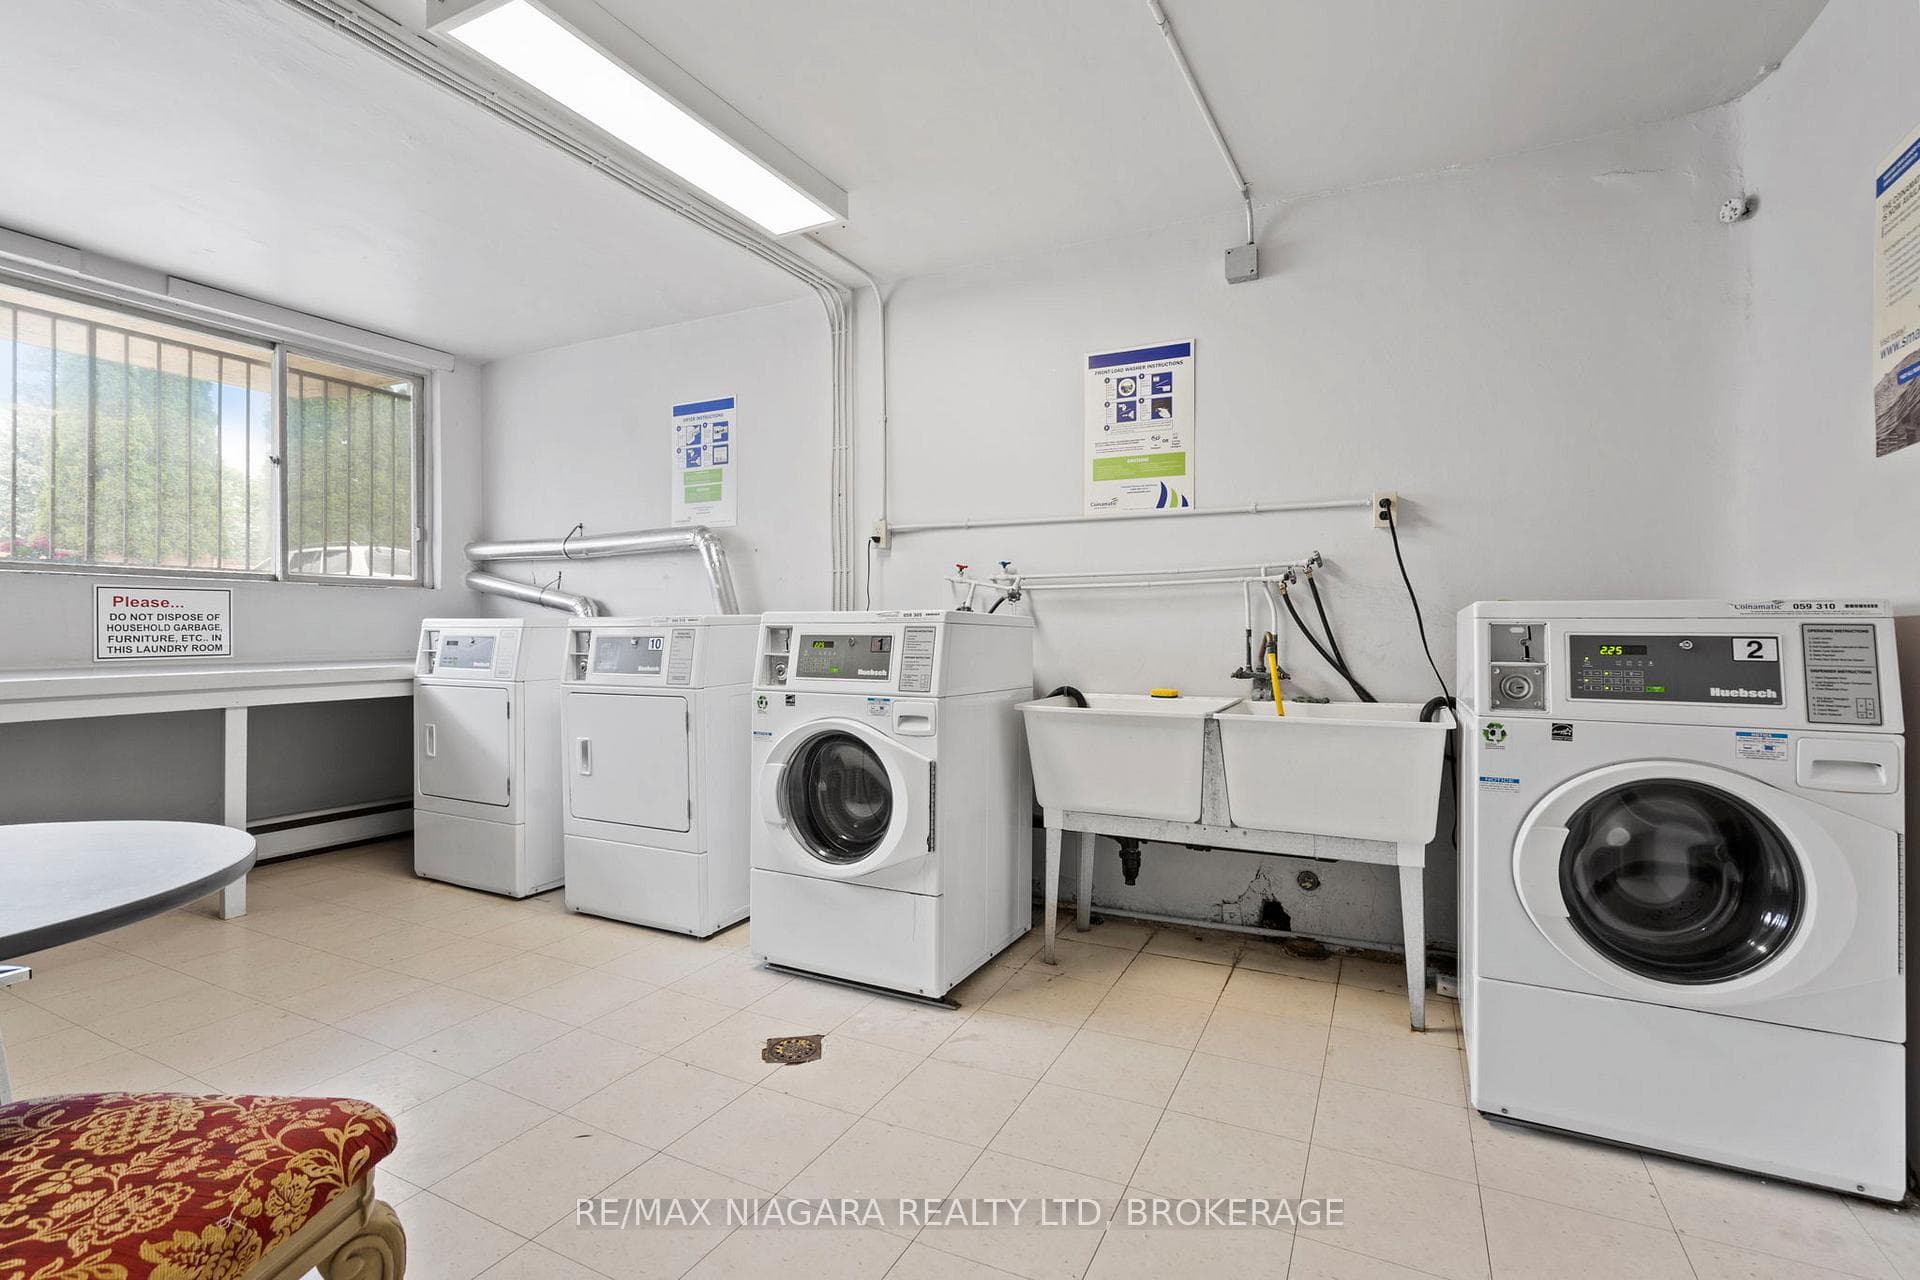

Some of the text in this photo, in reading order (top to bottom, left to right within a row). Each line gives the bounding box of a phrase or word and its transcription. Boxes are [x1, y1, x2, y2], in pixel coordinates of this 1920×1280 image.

[1147, 360, 1184, 369] INSTRUCTIONS
[112, 595, 184, 609] Please...
[109, 613, 221, 621] DO NOT DISPOSE OF
[106, 624, 223, 633] HOUSEHOLD GARBAGE,
[107, 634, 178, 644] FURNITURE,
[211, 634, 222, 642] IN
[650, 638, 661, 649] 10
[106, 644, 223, 654] THIS LAUNDRY ROOM
[877, 638, 884, 651] 1
[1746, 640, 1764, 659] 2
[1710, 687, 1777, 699] Huebsch
